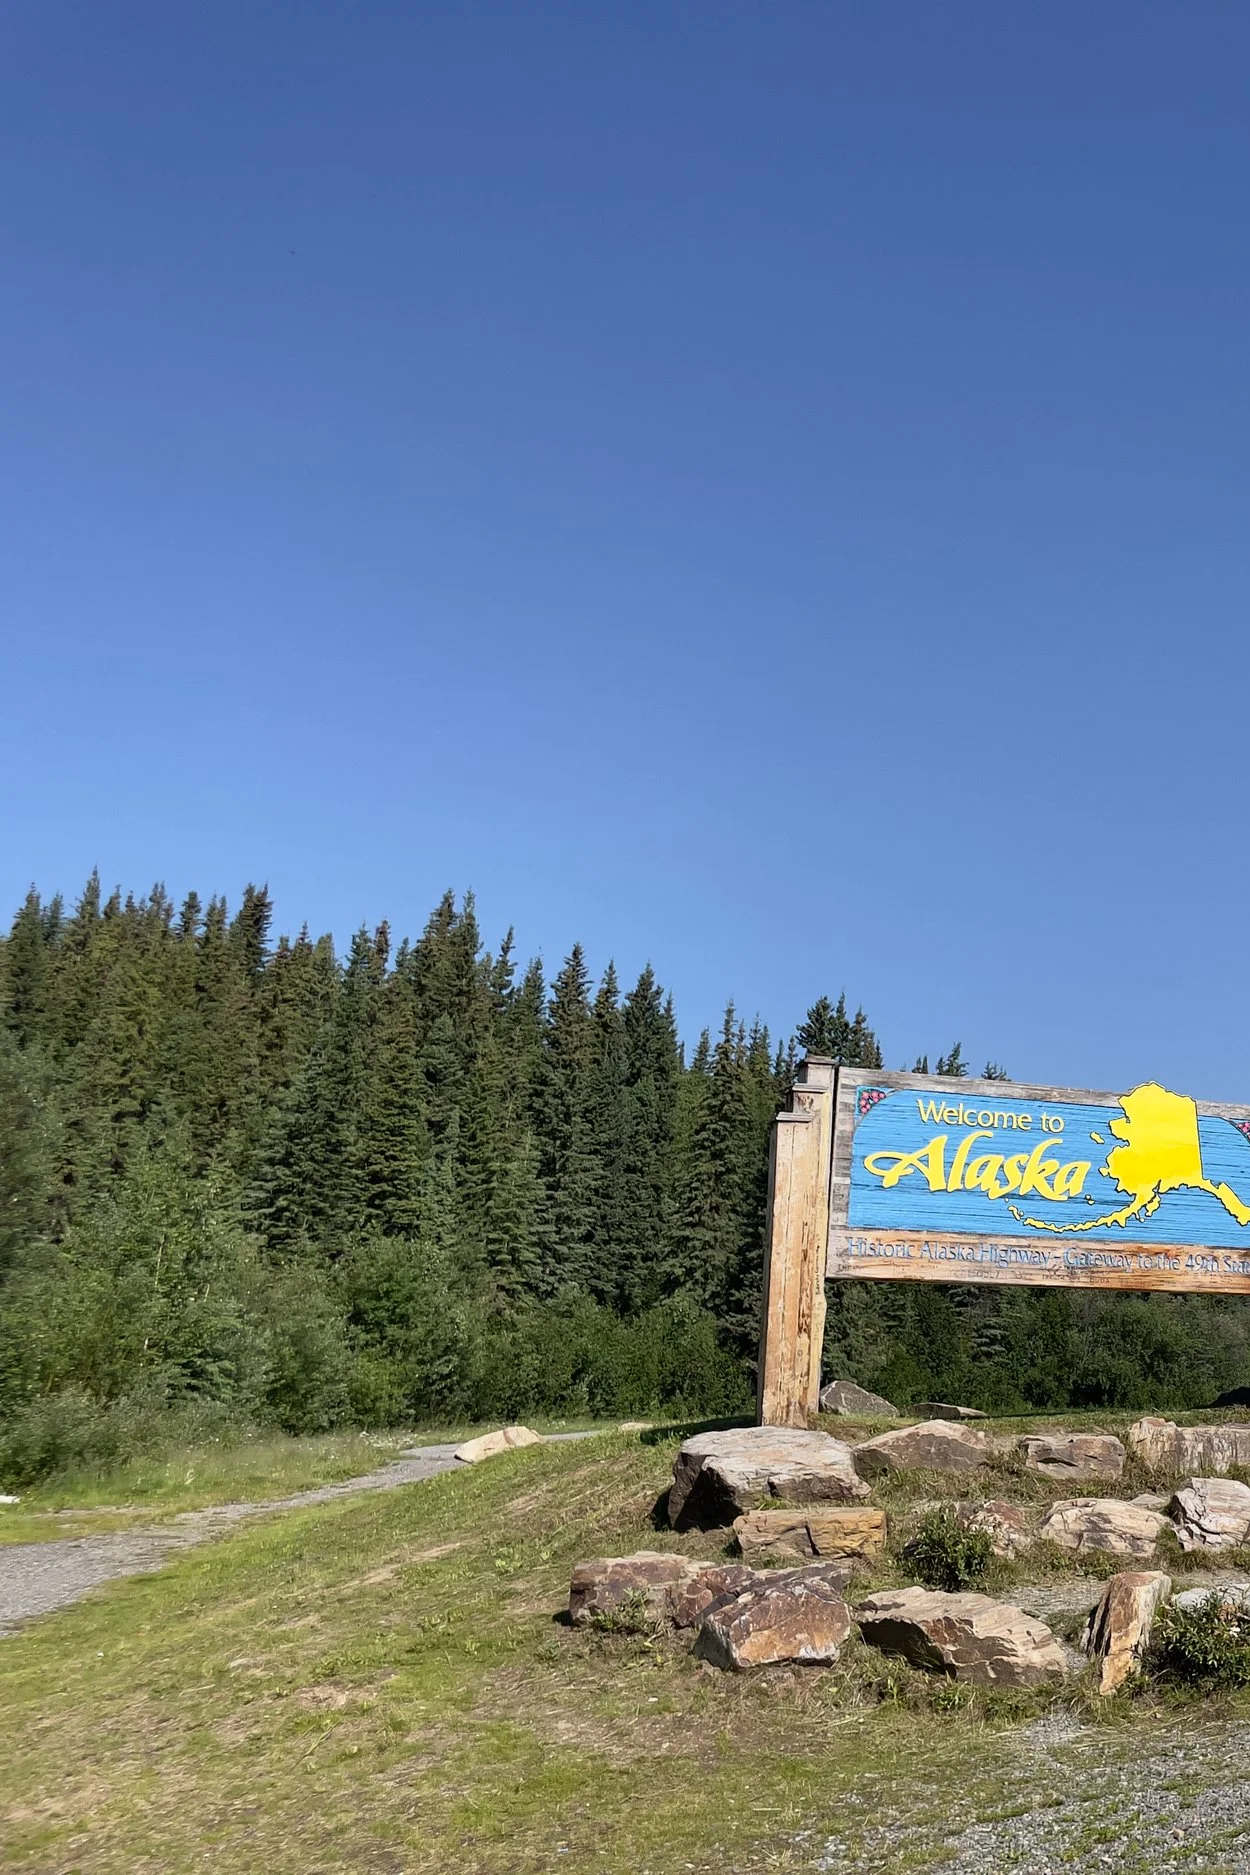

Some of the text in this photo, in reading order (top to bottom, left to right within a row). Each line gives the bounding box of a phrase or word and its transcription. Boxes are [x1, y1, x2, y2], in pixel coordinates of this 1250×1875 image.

[916, 1099, 1065, 1133] Welcome to
[864, 1131, 1091, 1202] Alaska
[847, 1237, 915, 1259] Historic
[920, 1240, 975, 1262] Alaska
[978, 1242, 1051, 1268] Highway
[1063, 1247, 1133, 1273] Gateway
[1137, 1252, 1152, 1269] to
[1156, 1254, 1180, 1271] the
[1185, 1254, 1219, 1272] 49th
